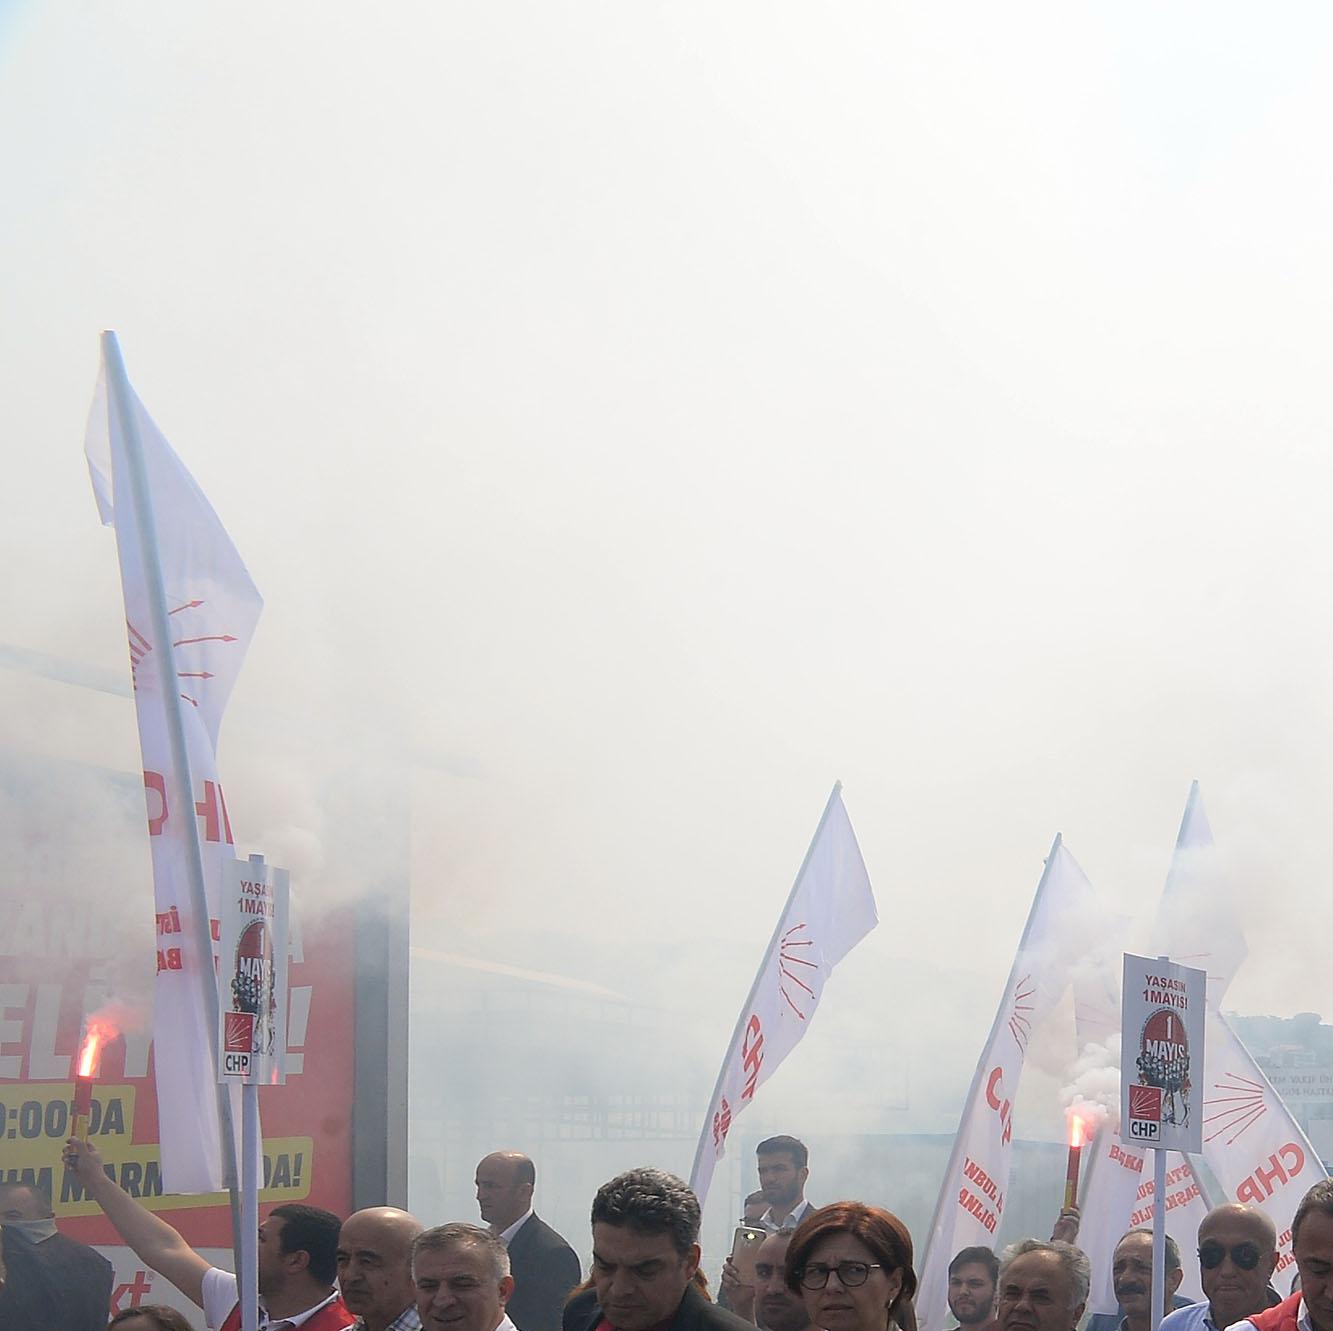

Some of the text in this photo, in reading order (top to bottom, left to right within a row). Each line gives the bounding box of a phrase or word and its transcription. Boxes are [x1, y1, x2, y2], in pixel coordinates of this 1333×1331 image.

[1144, 974, 1187, 993] YAŞASIN
[1146, 1038, 1186, 1062] MAYIS
[225, 1054, 249, 1072] CHP
[1131, 1120, 1158, 1138] CHP
